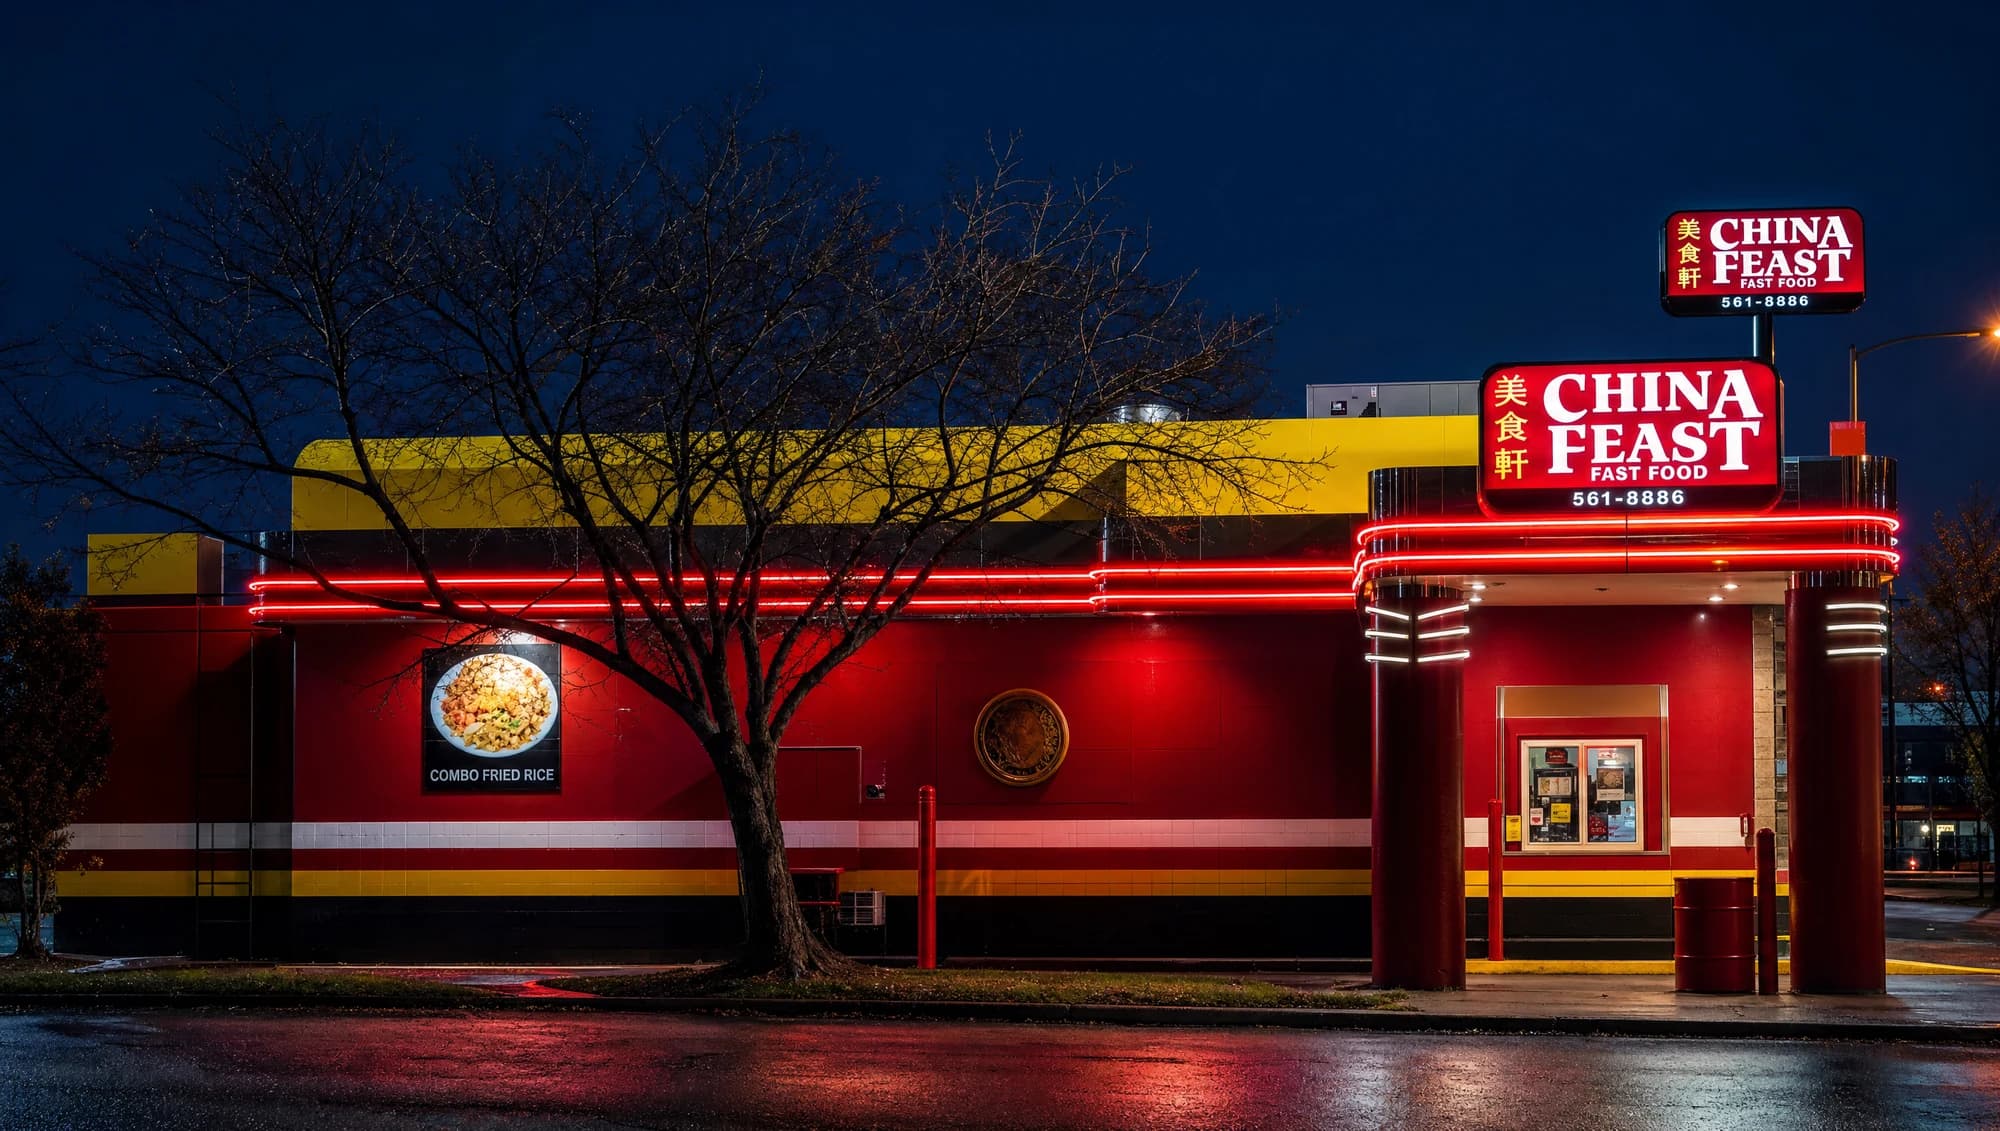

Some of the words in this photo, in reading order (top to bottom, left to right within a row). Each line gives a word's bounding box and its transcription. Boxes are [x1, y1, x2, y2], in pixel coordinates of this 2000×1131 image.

[1709, 215, 1854, 250] CHINA
[1677, 218, 1702, 289] 美食軒
[1712, 248, 1852, 284] FEAST
[1740, 278, 1773, 289] FAST
[1778, 277, 1817, 288] FOOD
[1721, 295, 1809, 309] 561-8886
[1543, 369, 1764, 423] CHINA
[1494, 374, 1529, 480] 美食軒
[1547, 421, 1761, 474] FEAST
[1591, 466, 1641, 482] FAST
[1648, 465, 1708, 481] FOOD
[1572, 489, 1685, 507] 561-8886
[430, 768, 479, 782] COMBO
[482, 768, 521, 781] FRIED
[524, 768, 555, 781] RICE
